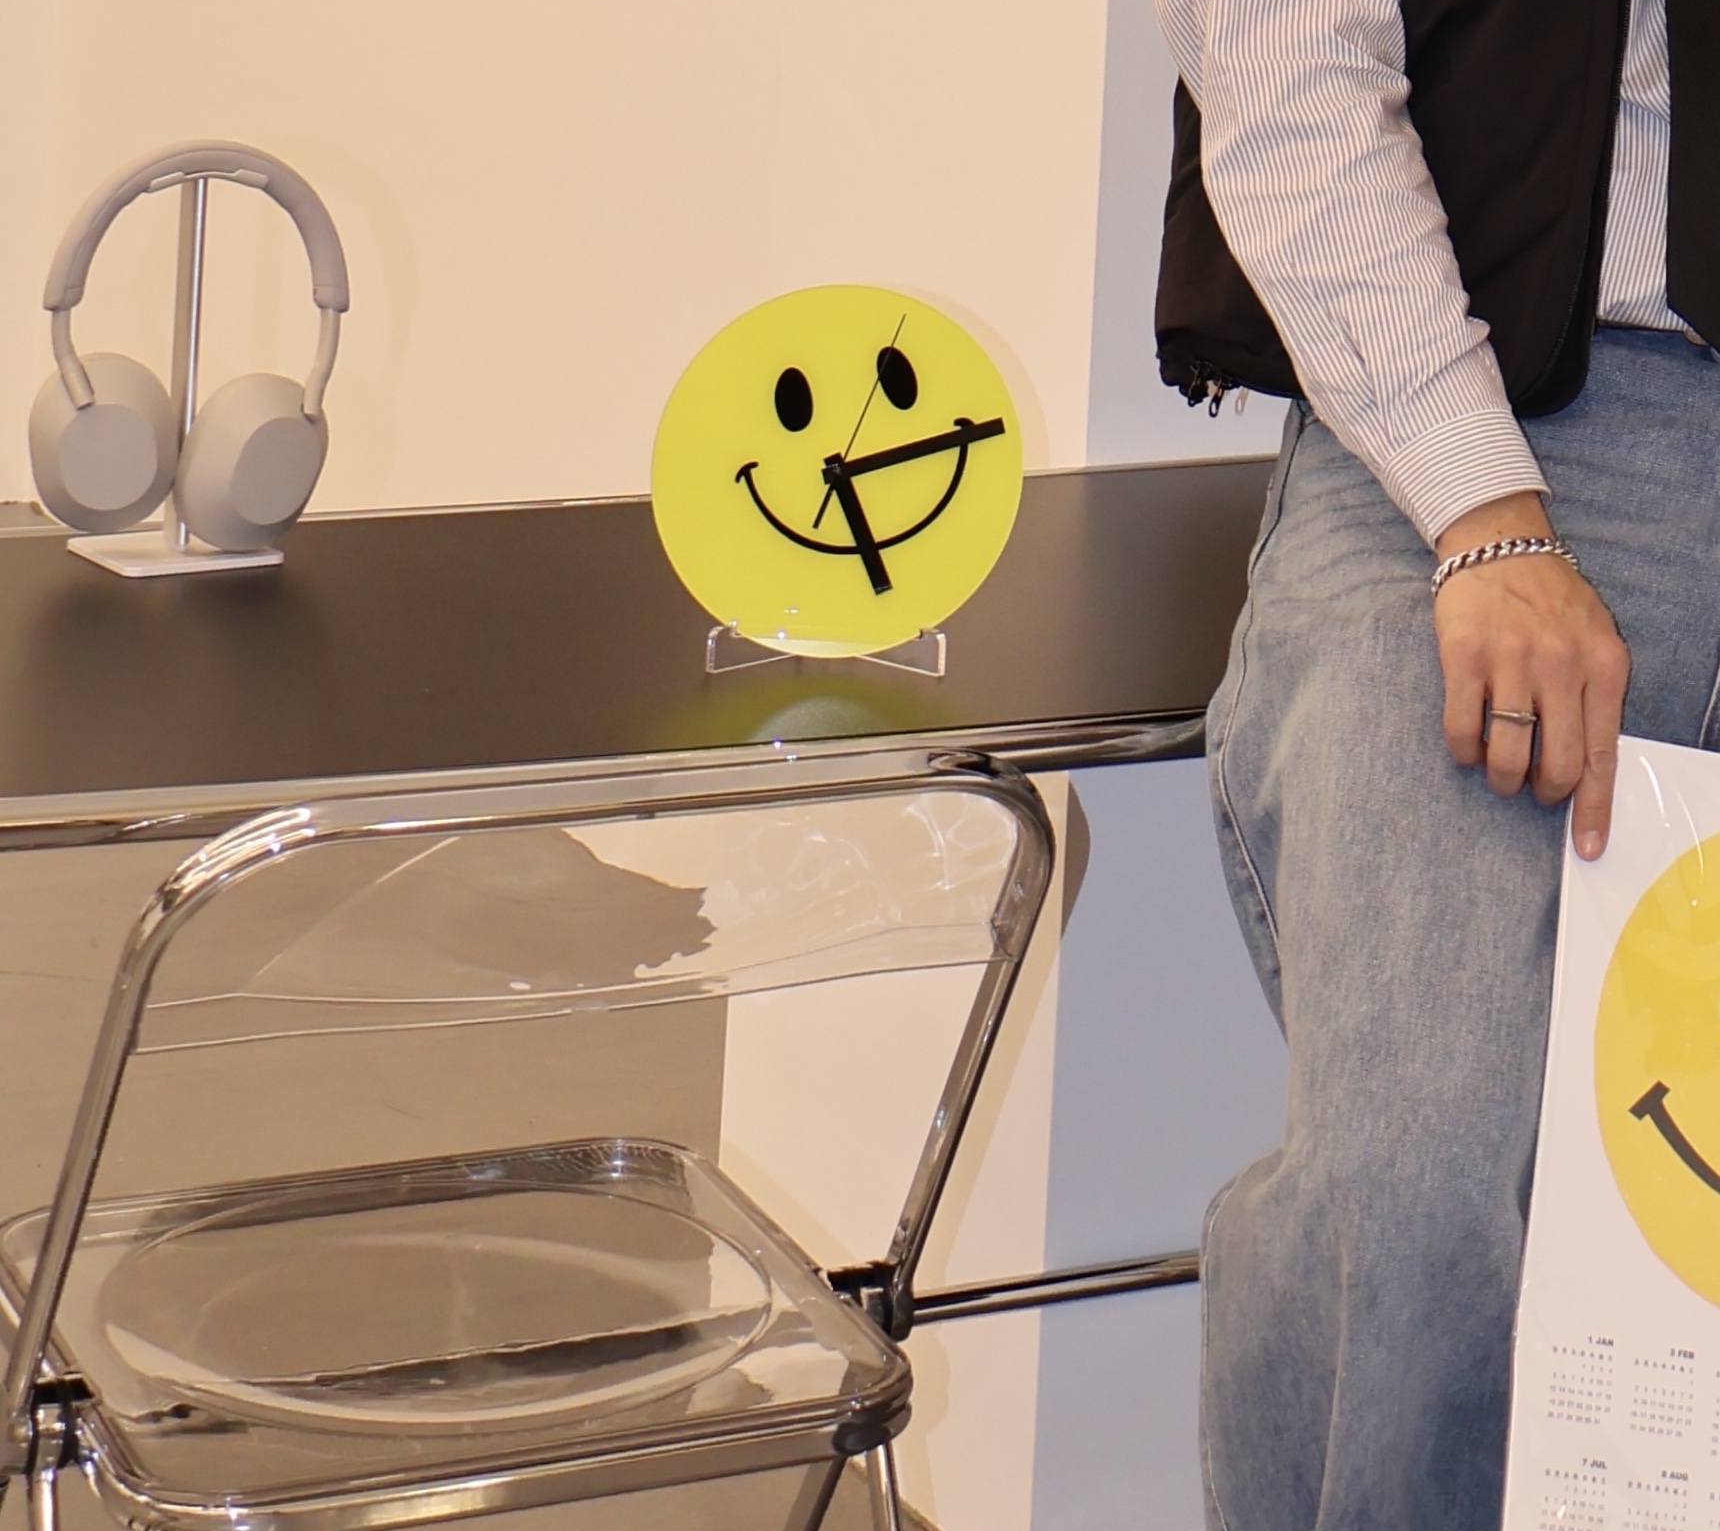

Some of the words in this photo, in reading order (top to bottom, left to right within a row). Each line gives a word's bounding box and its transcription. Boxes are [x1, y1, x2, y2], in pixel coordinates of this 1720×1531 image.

[1595, 1337, 1615, 1347] JAN
[1677, 1349, 1695, 1359] FEB
[1590, 1459, 1607, 1470] JUL
[1669, 1471, 1689, 1481] AUG
